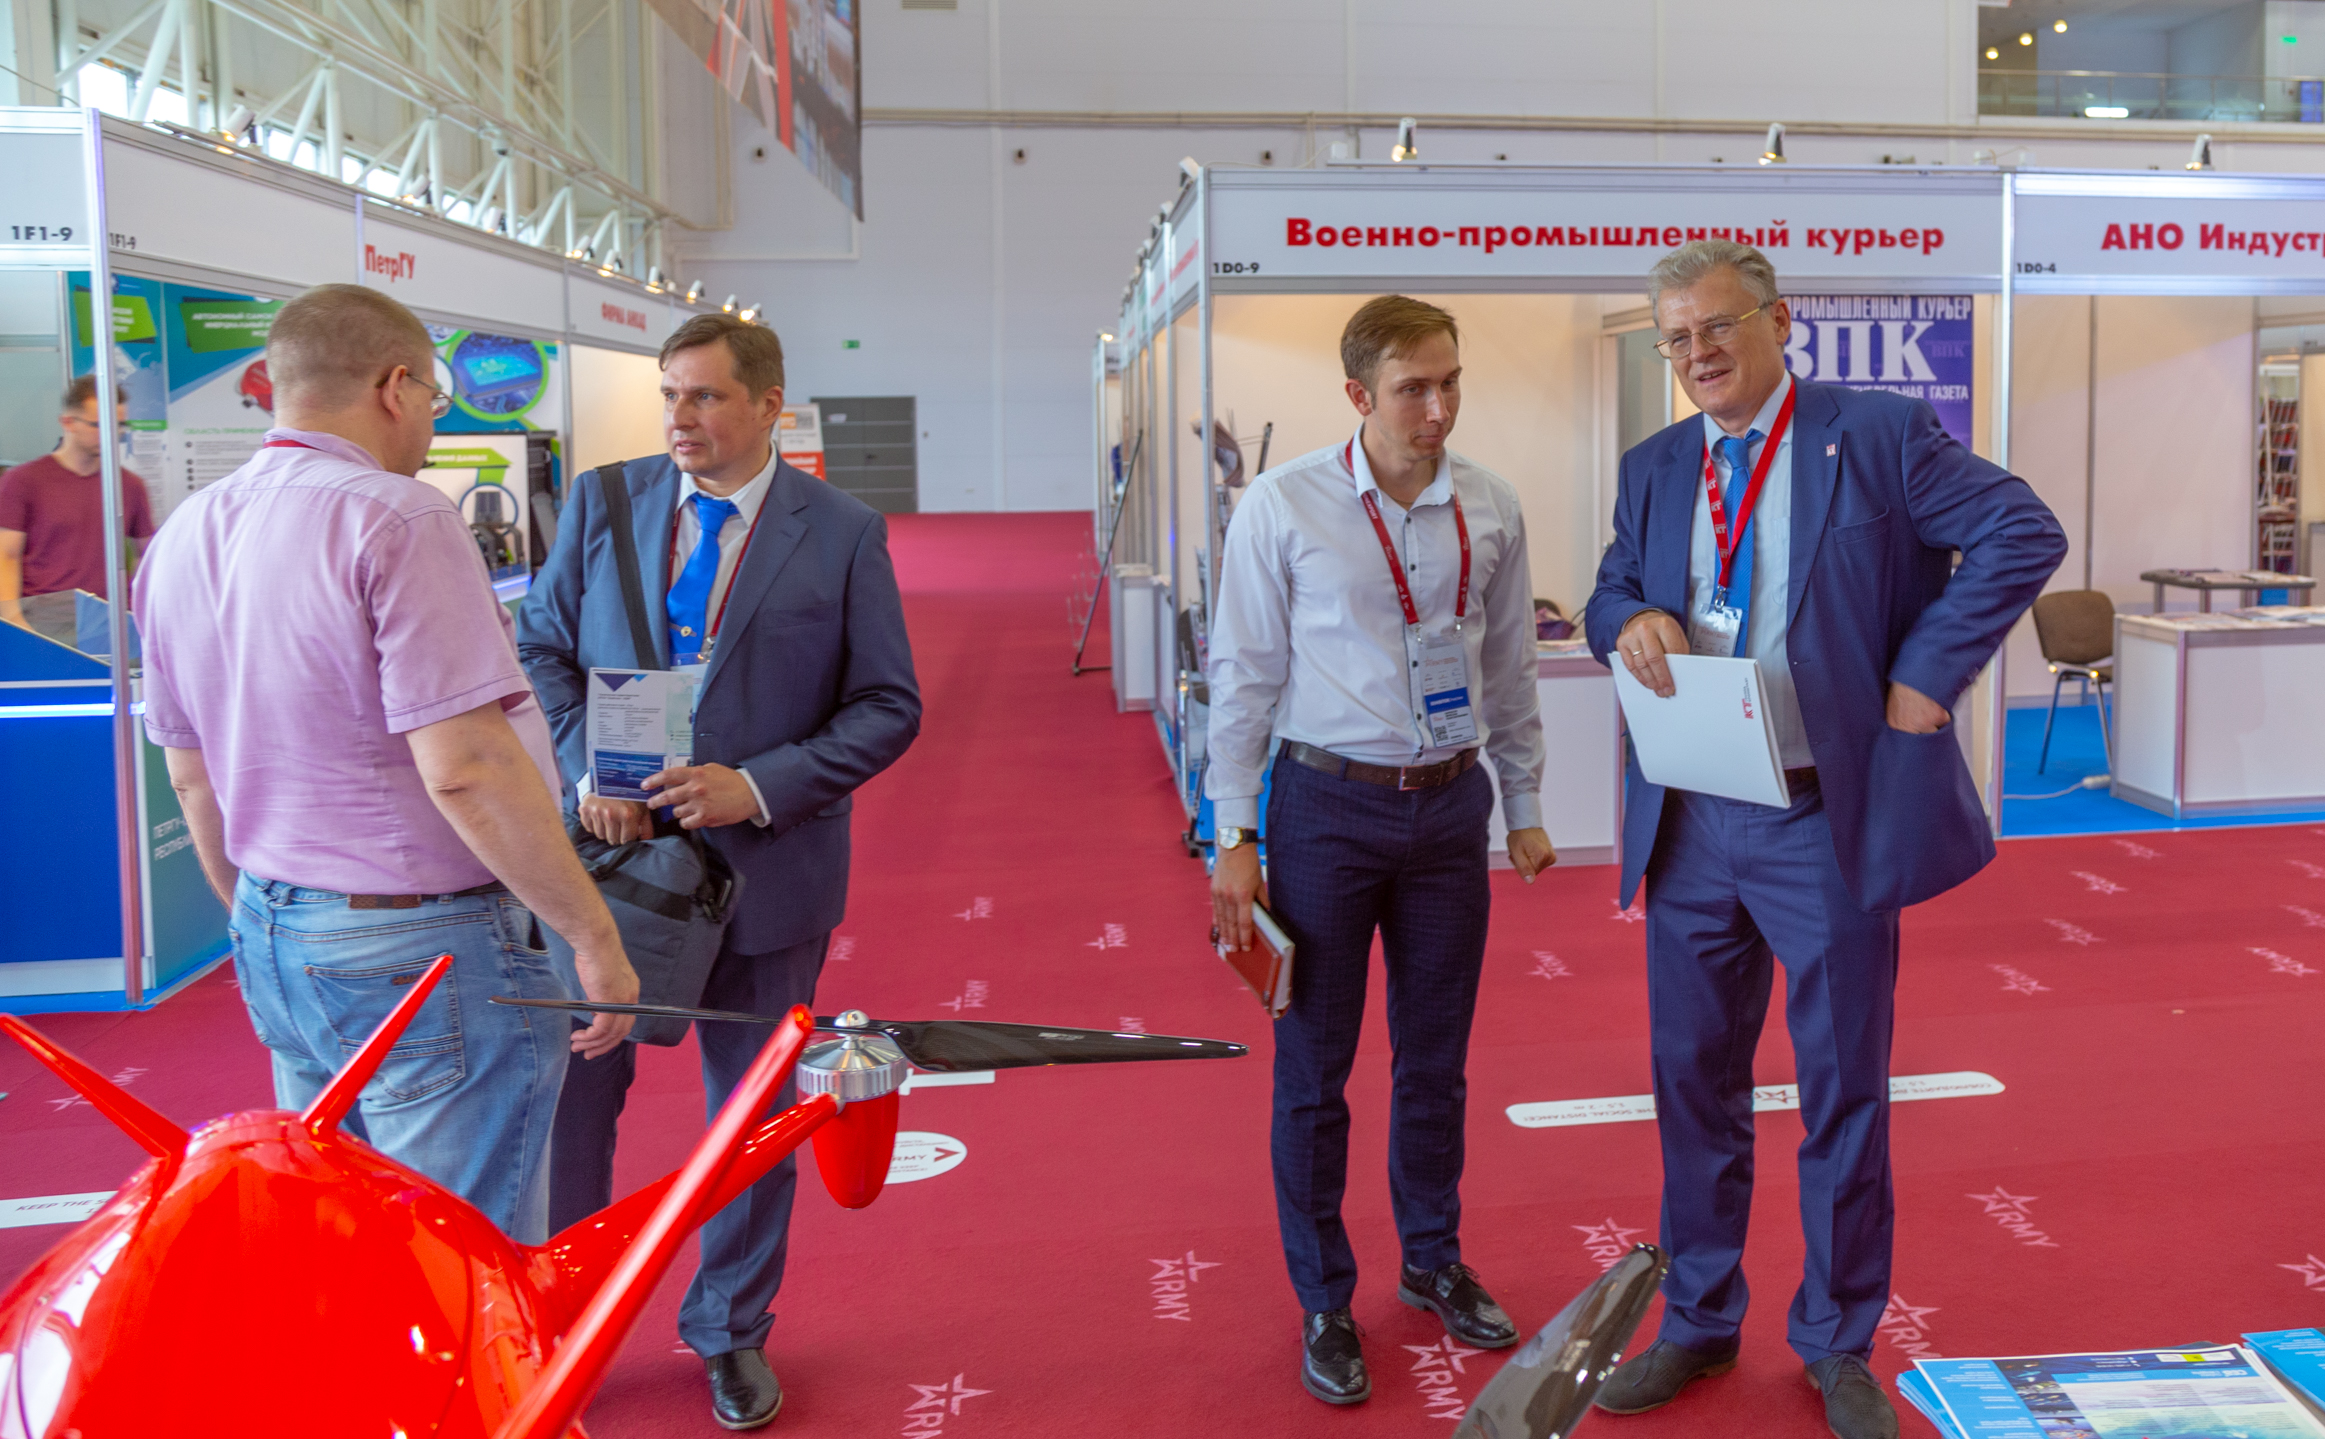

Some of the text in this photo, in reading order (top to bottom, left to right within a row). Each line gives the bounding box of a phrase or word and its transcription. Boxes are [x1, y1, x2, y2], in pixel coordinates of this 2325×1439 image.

[11, 225, 73, 241] 1F1-9
[109, 232, 136, 250] 1F1-9
[1286, 218, 1944, 255] Военно-промышленный курьер
[2101, 222, 2325, 258] АНО Индуст
[364, 243, 416, 284] ПетрГУ
[1212, 261, 1260, 274] 1D0-9
[2016, 262, 2056, 274] 1D0-4
[1917, 296, 1971, 320] КУРЬЕР
[1785, 320, 1938, 383] ВПК
[1930, 385, 1969, 399] ГАЗЕТА
[891, 1154, 928, 1162] RMY
[14, 1202, 60, 1212] KEEP
[62, 1199, 94, 1208] THE
[1963, 1185, 2061, 1248] ARMY
[1571, 1216, 1648, 1274] ARM
[1147, 1249, 1224, 1322] ARMY
[1876, 1291, 1943, 1361] ARM
[1400, 1333, 1488, 1420] ARMY
